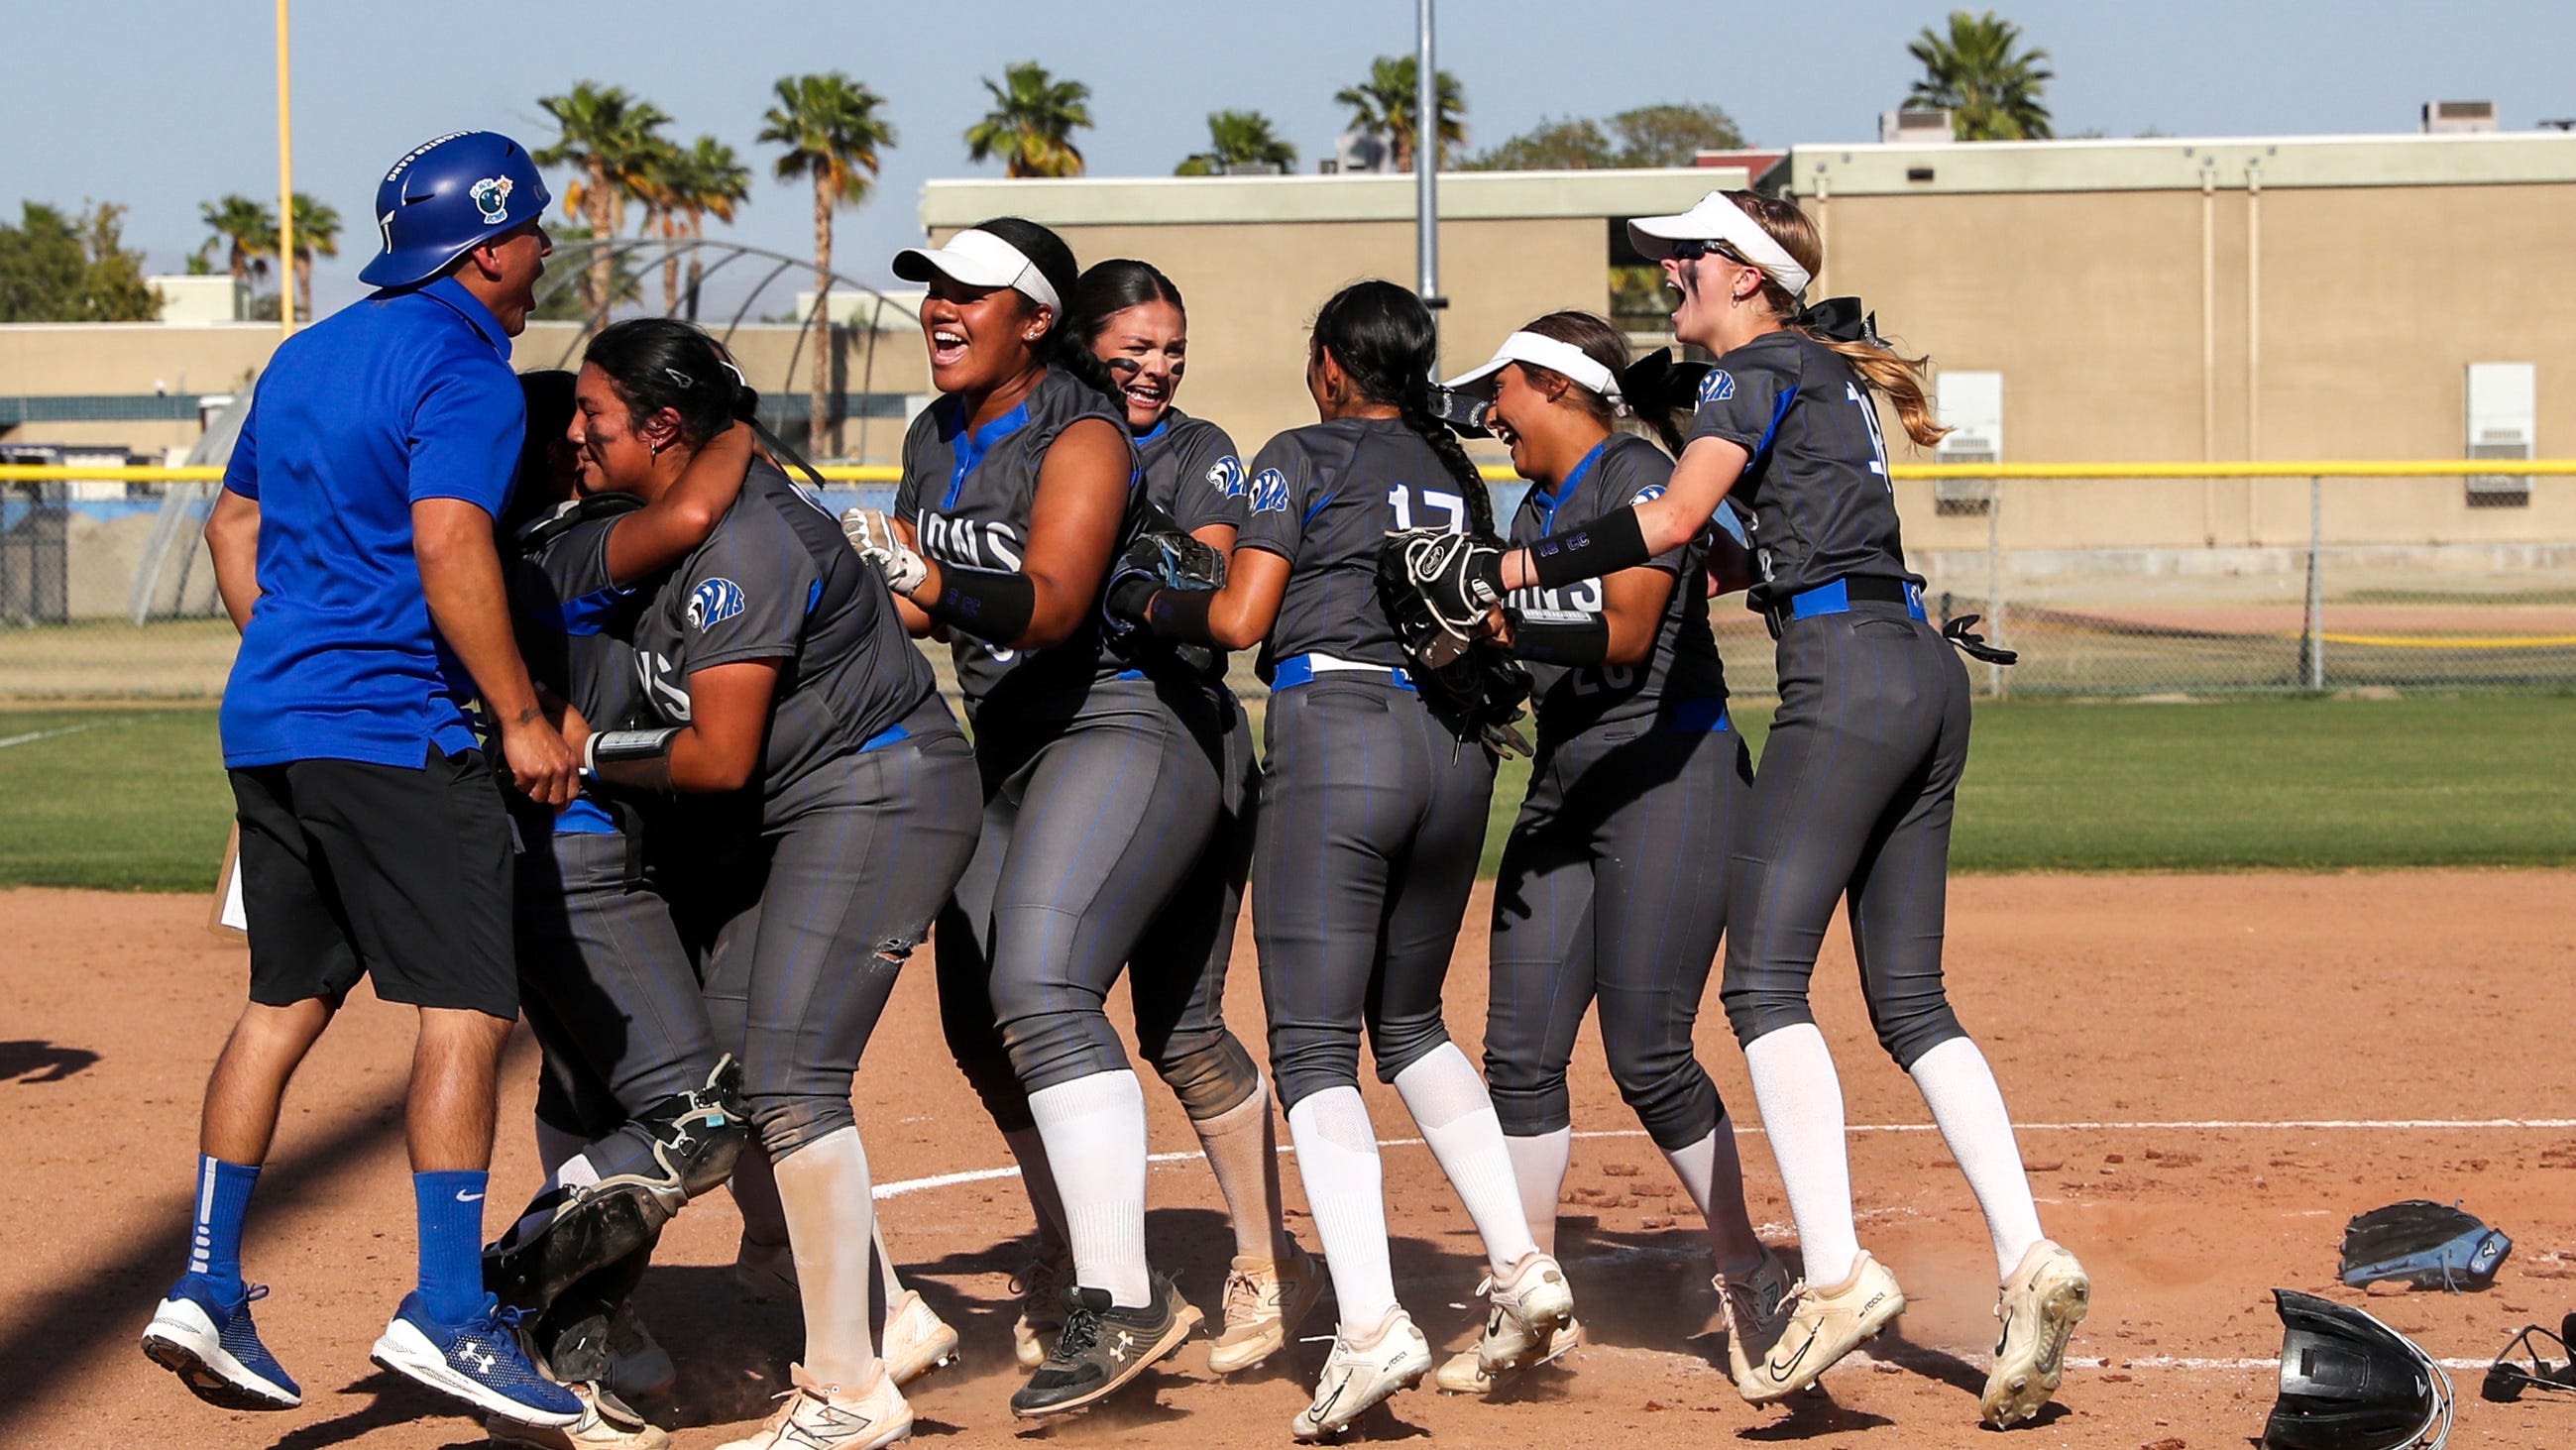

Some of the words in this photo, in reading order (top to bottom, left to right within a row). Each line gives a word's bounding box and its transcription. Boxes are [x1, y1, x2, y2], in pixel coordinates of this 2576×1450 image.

[414, 130, 482, 156] AUGHTER
[387, 155, 415, 181] GANG
[1388, 483, 1465, 536] 17
[917, 507, 1023, 573] IONS
